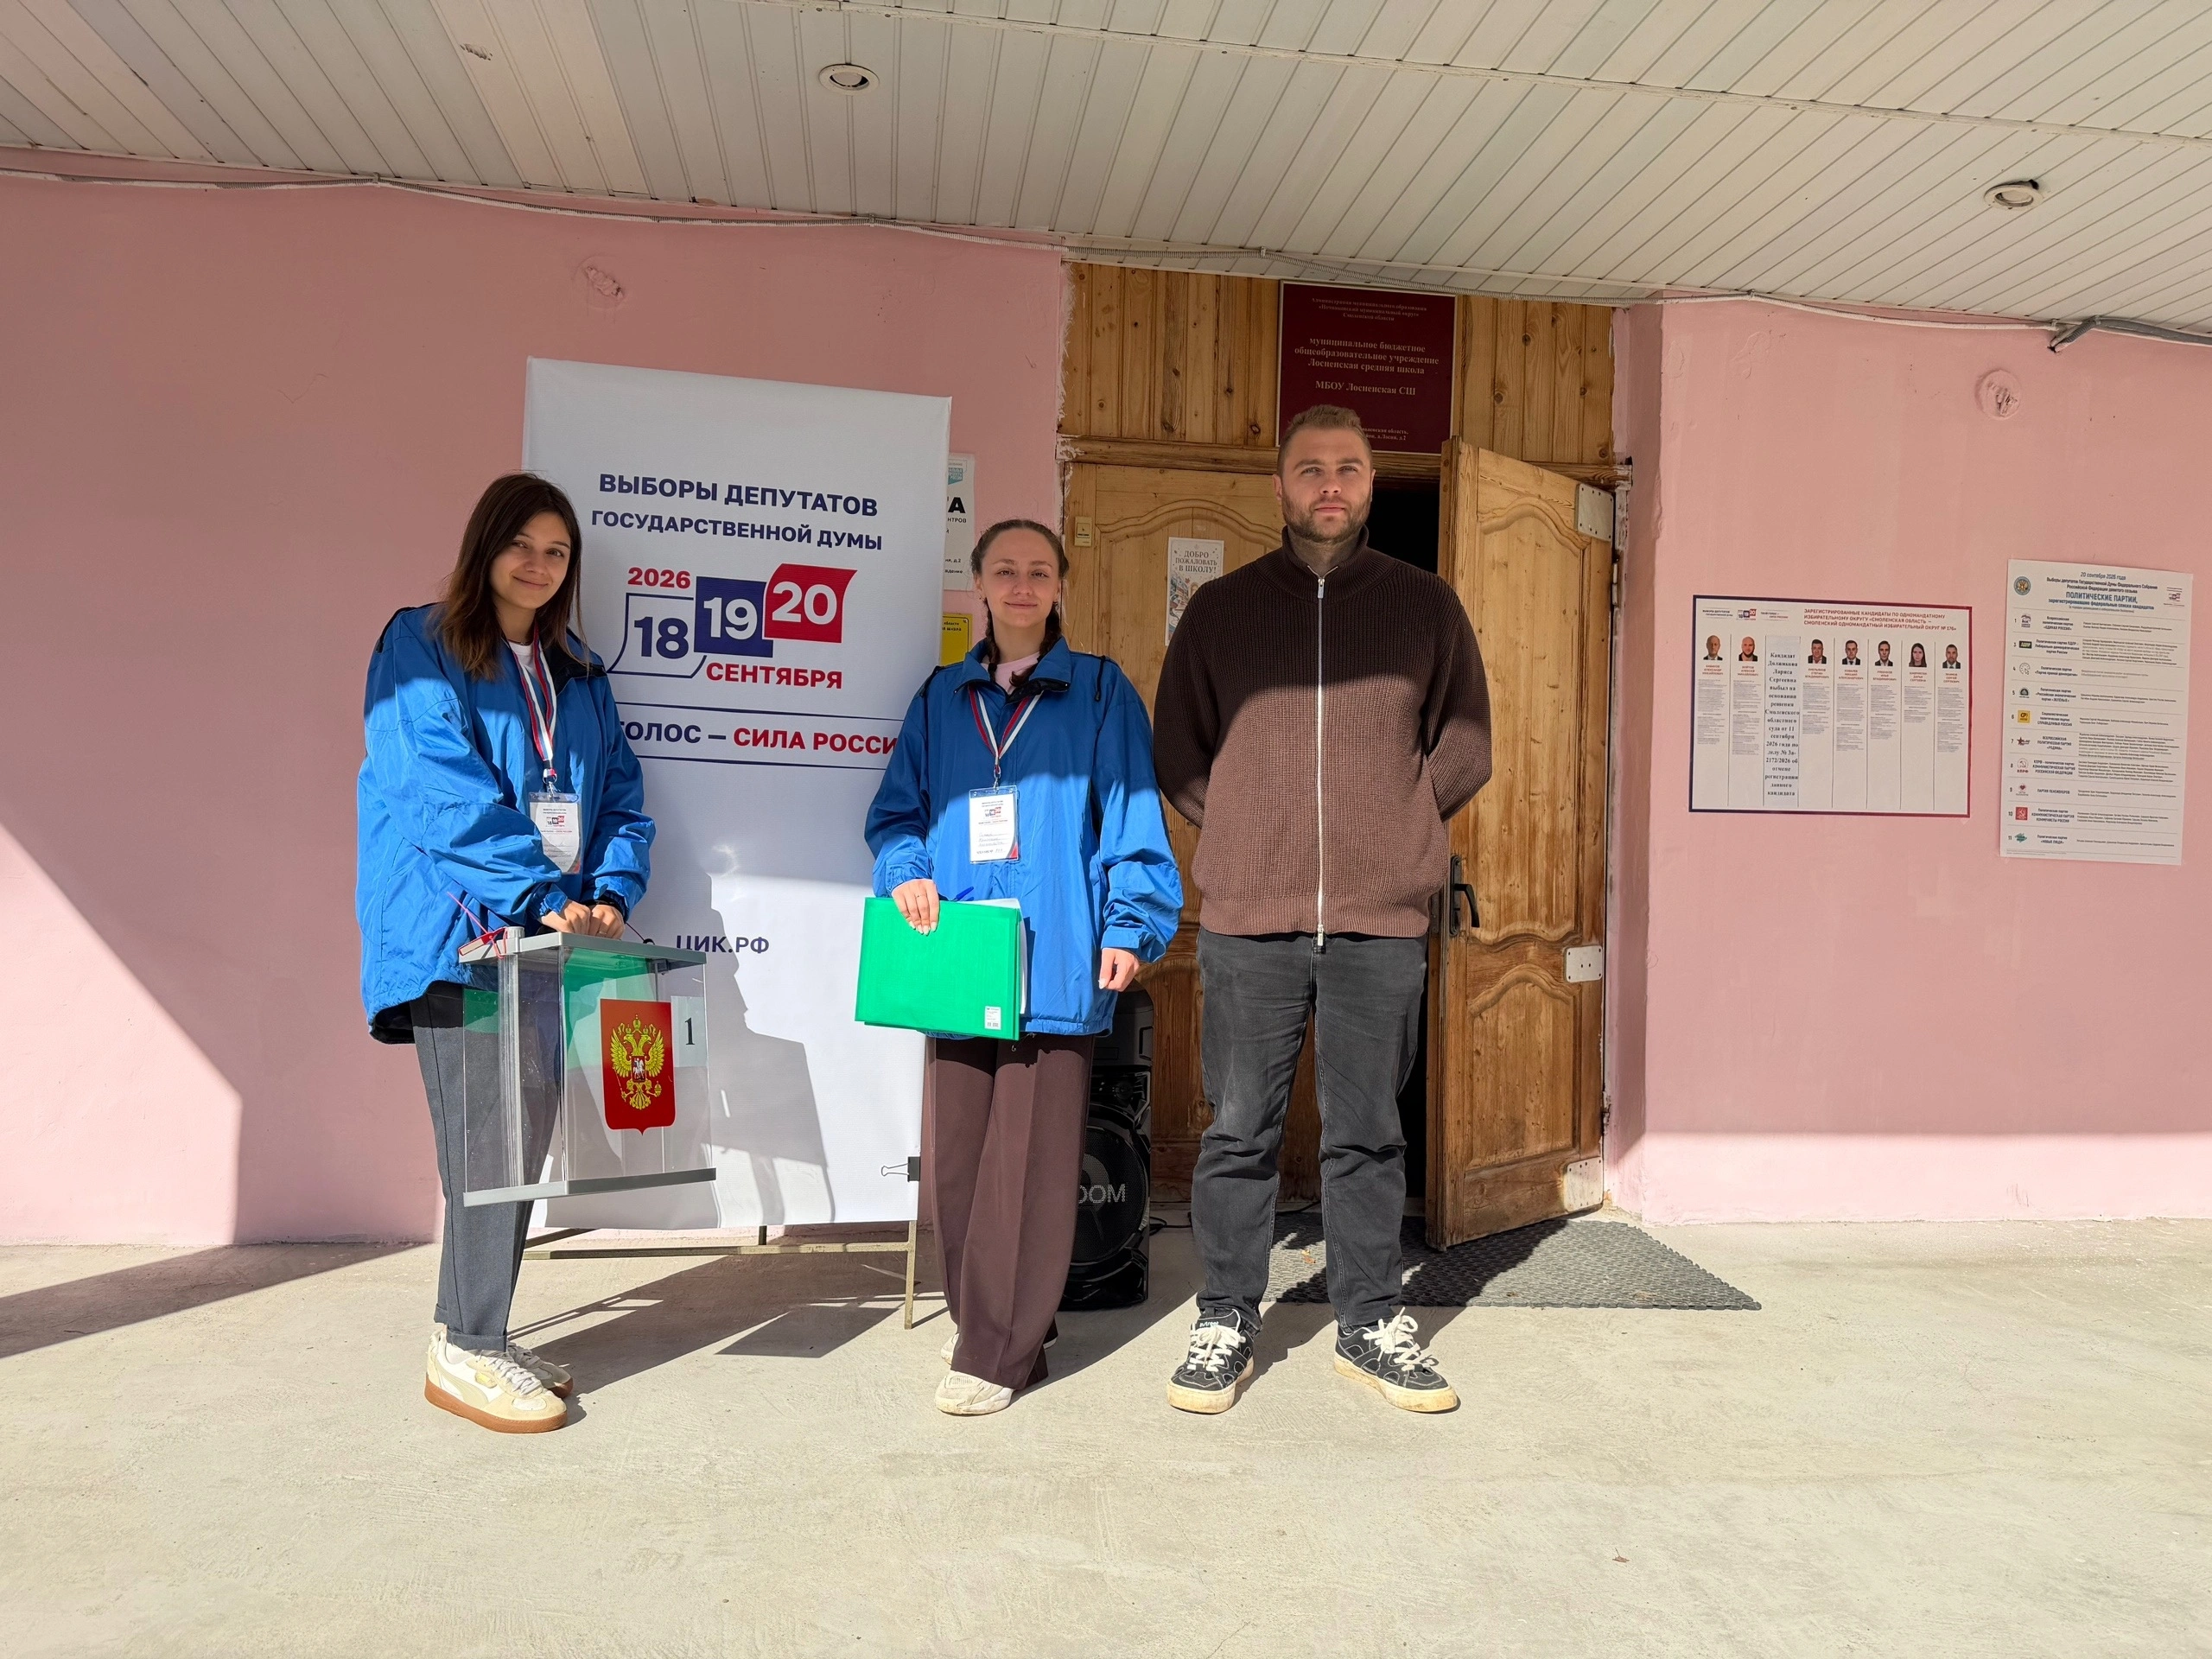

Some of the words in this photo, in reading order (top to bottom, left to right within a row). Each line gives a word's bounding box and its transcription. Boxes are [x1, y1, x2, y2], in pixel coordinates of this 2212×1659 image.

[1294, 346, 1387, 360] общеобразовательное
[1389, 354, 1440, 365] учреждение
[1309, 338, 1377, 349] муниципальное
[1380, 341, 1426, 353] бюджетное
[1308, 358, 1358, 370] Лосненская
[1361, 363, 1395, 373] средняя
[1315, 380, 1344, 391] МБОУ
[1346, 383, 1396, 394] Лосненская
[1399, 386, 1416, 395] СШ
[600, 474, 717, 501] ВЫБОРЫ
[724, 484, 878, 517] ДЕПУТАТОВ
[591, 510, 812, 543] ГОСУДАРСТВЕННОЙ
[817, 530, 882, 550] ДУМЫ
[1175, 557, 1217, 566] ПОЖАЛОВАТЬ
[627, 567, 691, 589] 2026
[2066, 591, 2113, 601] ПОЛИТИЧЕСКИЕ
[2113, 594, 2138, 604] ПАРТИИ,
[634, 616, 689, 659] 18
[703, 597, 758, 640] 19
[772, 581, 837, 625] 20
[706, 662, 842, 690] СЕНТЯБРЯ
[620, 721, 702, 743] ОЛОС
[734, 728, 806, 749] СИЛА
[676, 935, 770, 954] ЦИК.РФ
[684, 1017, 696, 1046] 1
